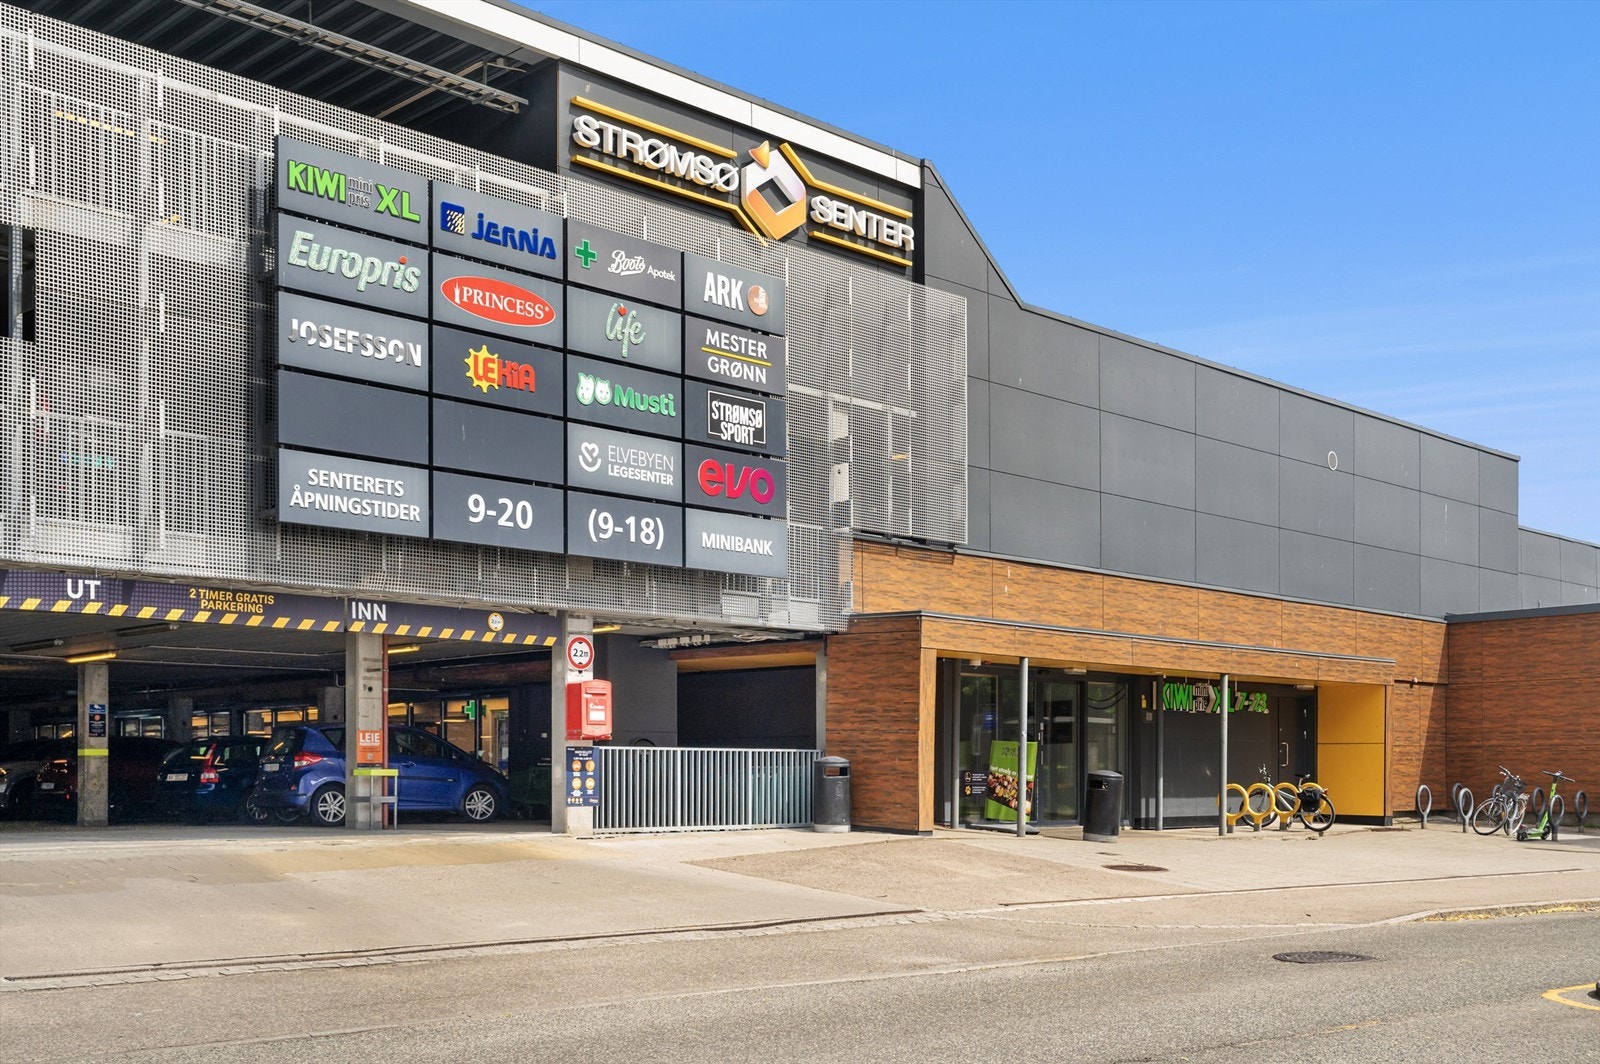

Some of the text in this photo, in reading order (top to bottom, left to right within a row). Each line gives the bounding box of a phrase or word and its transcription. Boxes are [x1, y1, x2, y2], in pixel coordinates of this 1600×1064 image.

[287, 160, 421, 223] KIWI mini XL
[573, 114, 915, 251] STRØMSØ SENTER
[347, 190, 370, 209] pris
[287, 230, 421, 293] Europris
[608, 249, 676, 282] Boots Apotek
[462, 285, 545, 319] PRINCESS
[703, 271, 744, 312] ARK
[288, 318, 422, 367] JOSEFSSON
[605, 303, 646, 358] life
[705, 329, 768, 359] MESTER
[707, 356, 767, 385] GRØNN
[614, 384, 676, 417] Musti
[711, 400, 763, 429] STRØMSØ
[720, 422, 756, 445] SPORT
[608, 445, 674, 472] ELVEBYEN
[307, 468, 404, 497] SENTERETS
[608, 463, 674, 486] LEGESENTER
[698, 458, 776, 505] evo
[289, 484, 421, 522] ÅPNINGSTIDER
[467, 493, 534, 530] 9-20
[588, 508, 665, 550] (9-18)
[702, 531, 773, 556] MINIBANK
[66, 578, 101, 600] UT
[189, 588, 275, 605] 2 TIMER GRATIS
[200, 600, 264, 614] PARKERING
[351, 601, 387, 621] INN
[359, 732, 381, 743] LEIE
